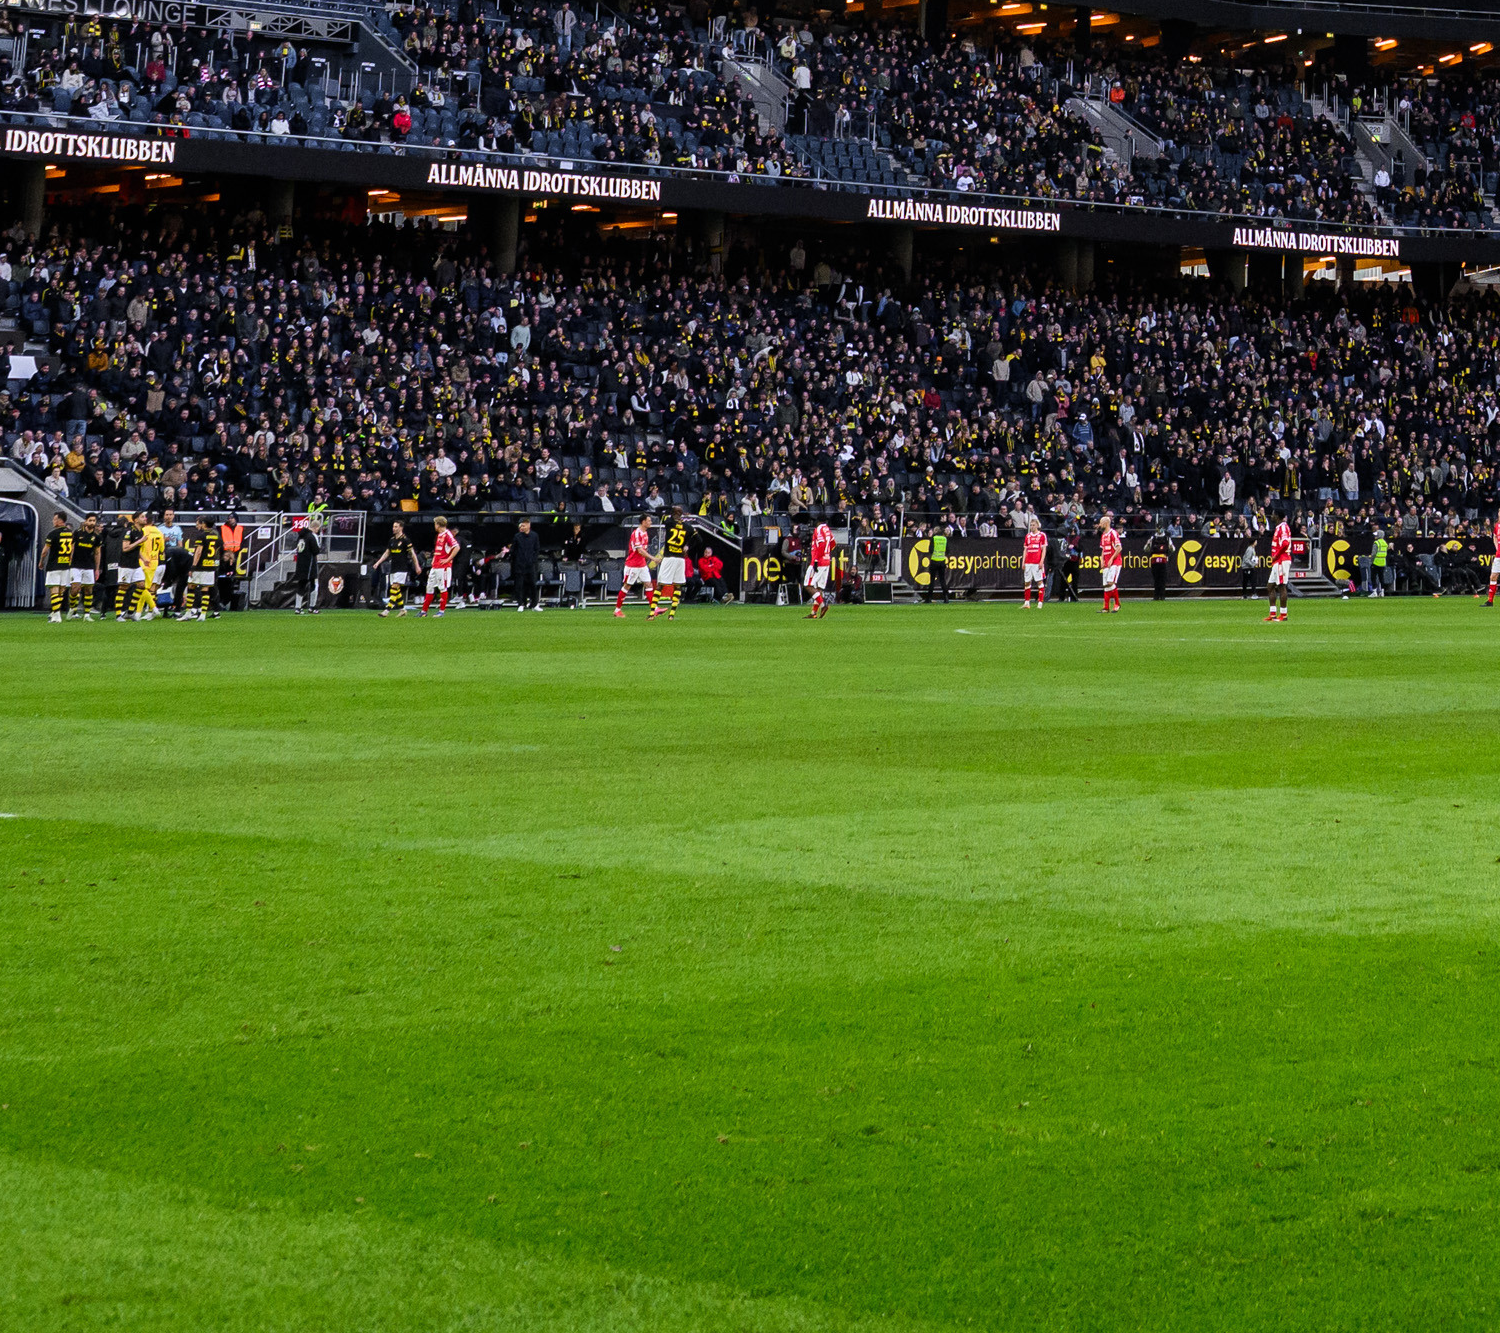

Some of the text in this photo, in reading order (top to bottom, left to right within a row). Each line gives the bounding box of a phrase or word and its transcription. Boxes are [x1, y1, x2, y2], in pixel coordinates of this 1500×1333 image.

[6, 129, 177, 165] IDROTTSKLUBBEN
[427, 162, 661, 202] ALLMÄNNA IDROTTSKLUBBEN
[868, 198, 1061, 231] ALLMÄNNA IDROTTSKLUBBEN
[1232, 227, 1400, 258] ALLMÄNNA IDROTTSKLUBBEN
[293, 519, 310, 529] 130
[151, 537, 160, 552] 15
[668, 528, 687, 546] 25
[59, 538, 73, 555] 33
[207, 542, 216, 557] 5
[1293, 544, 1304, 552] 128
